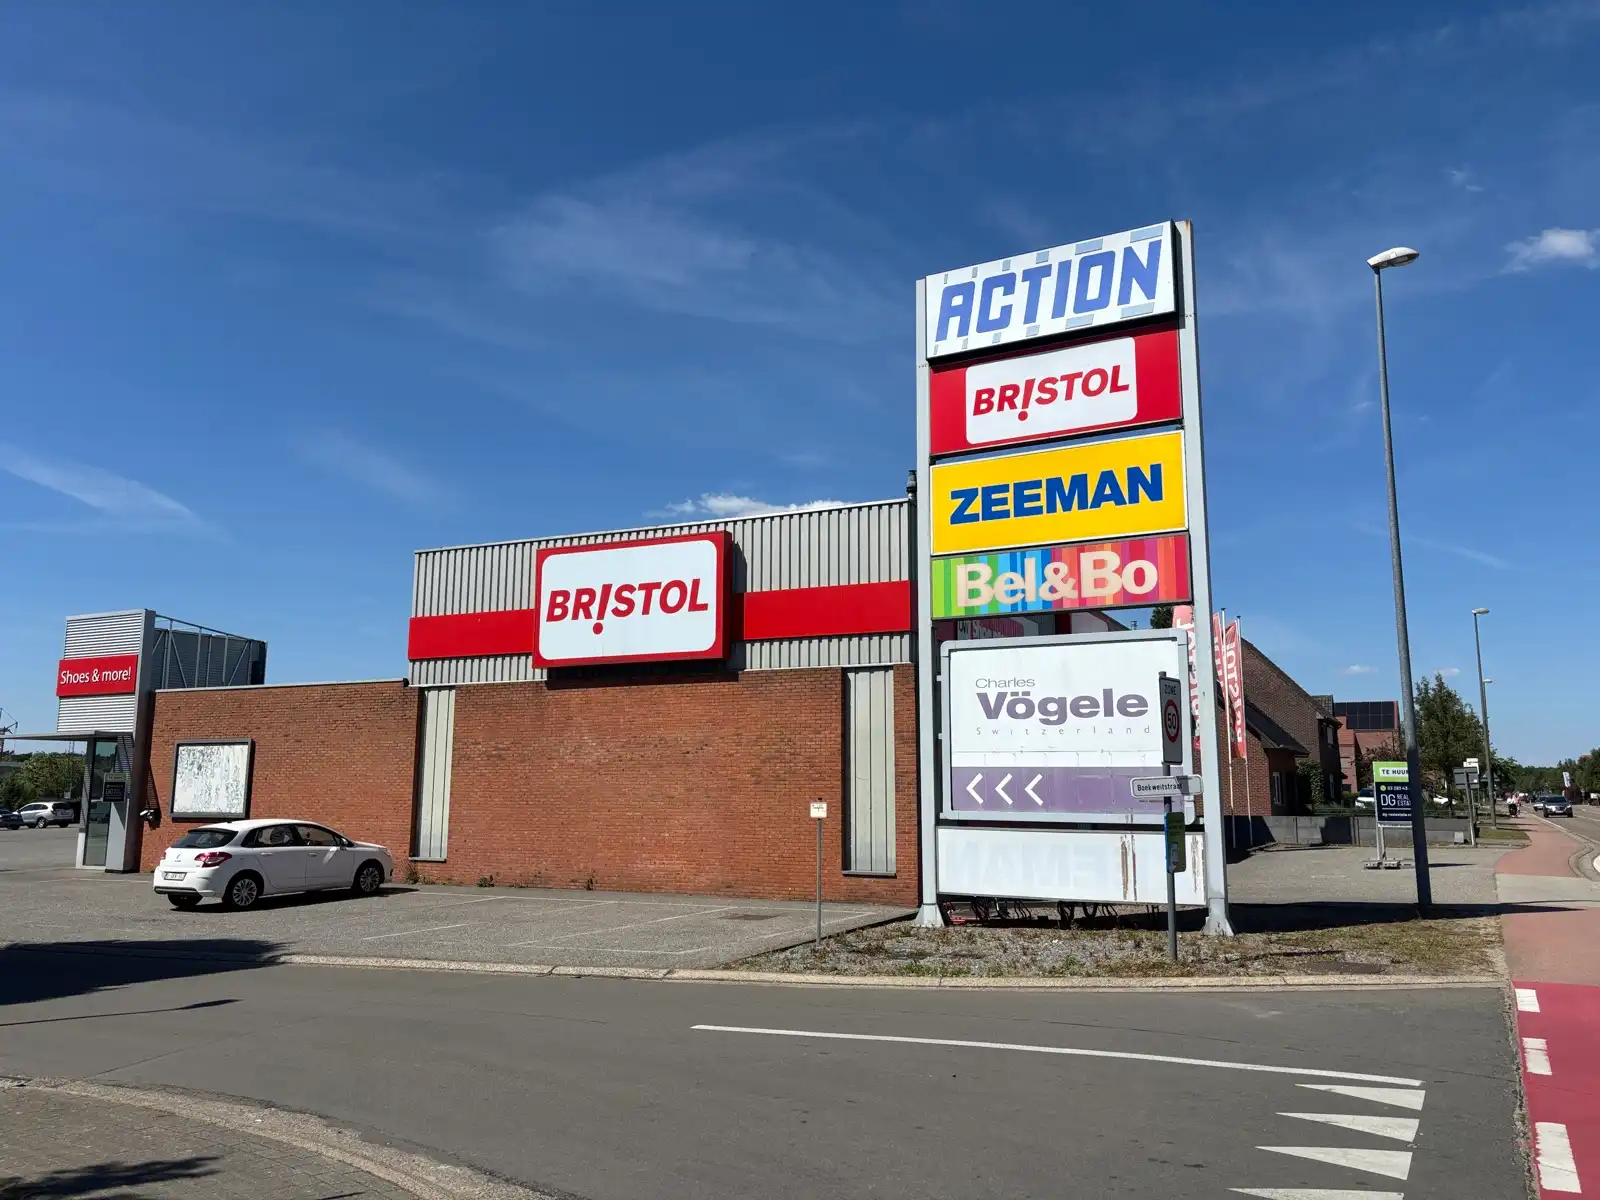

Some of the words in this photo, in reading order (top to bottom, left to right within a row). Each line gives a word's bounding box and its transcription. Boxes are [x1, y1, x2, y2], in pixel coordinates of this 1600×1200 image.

[936, 239, 1162, 342] ACTION
[950, 463, 1163, 525] ZEEMAN
[956, 551, 1158, 608] Bel&Bo
[60, 670, 90, 685] Shoes
[91, 668, 100, 683] &
[102, 666, 132, 682] more!
[975, 677, 1036, 689] Charles
[1164, 684, 1176, 696] ZONE
[976, 688, 1149, 726] Vögele
[1167, 712, 1177, 730] 50
[976, 725, 1150, 736] Switzerland
[1380, 793, 1396, 806] DG
